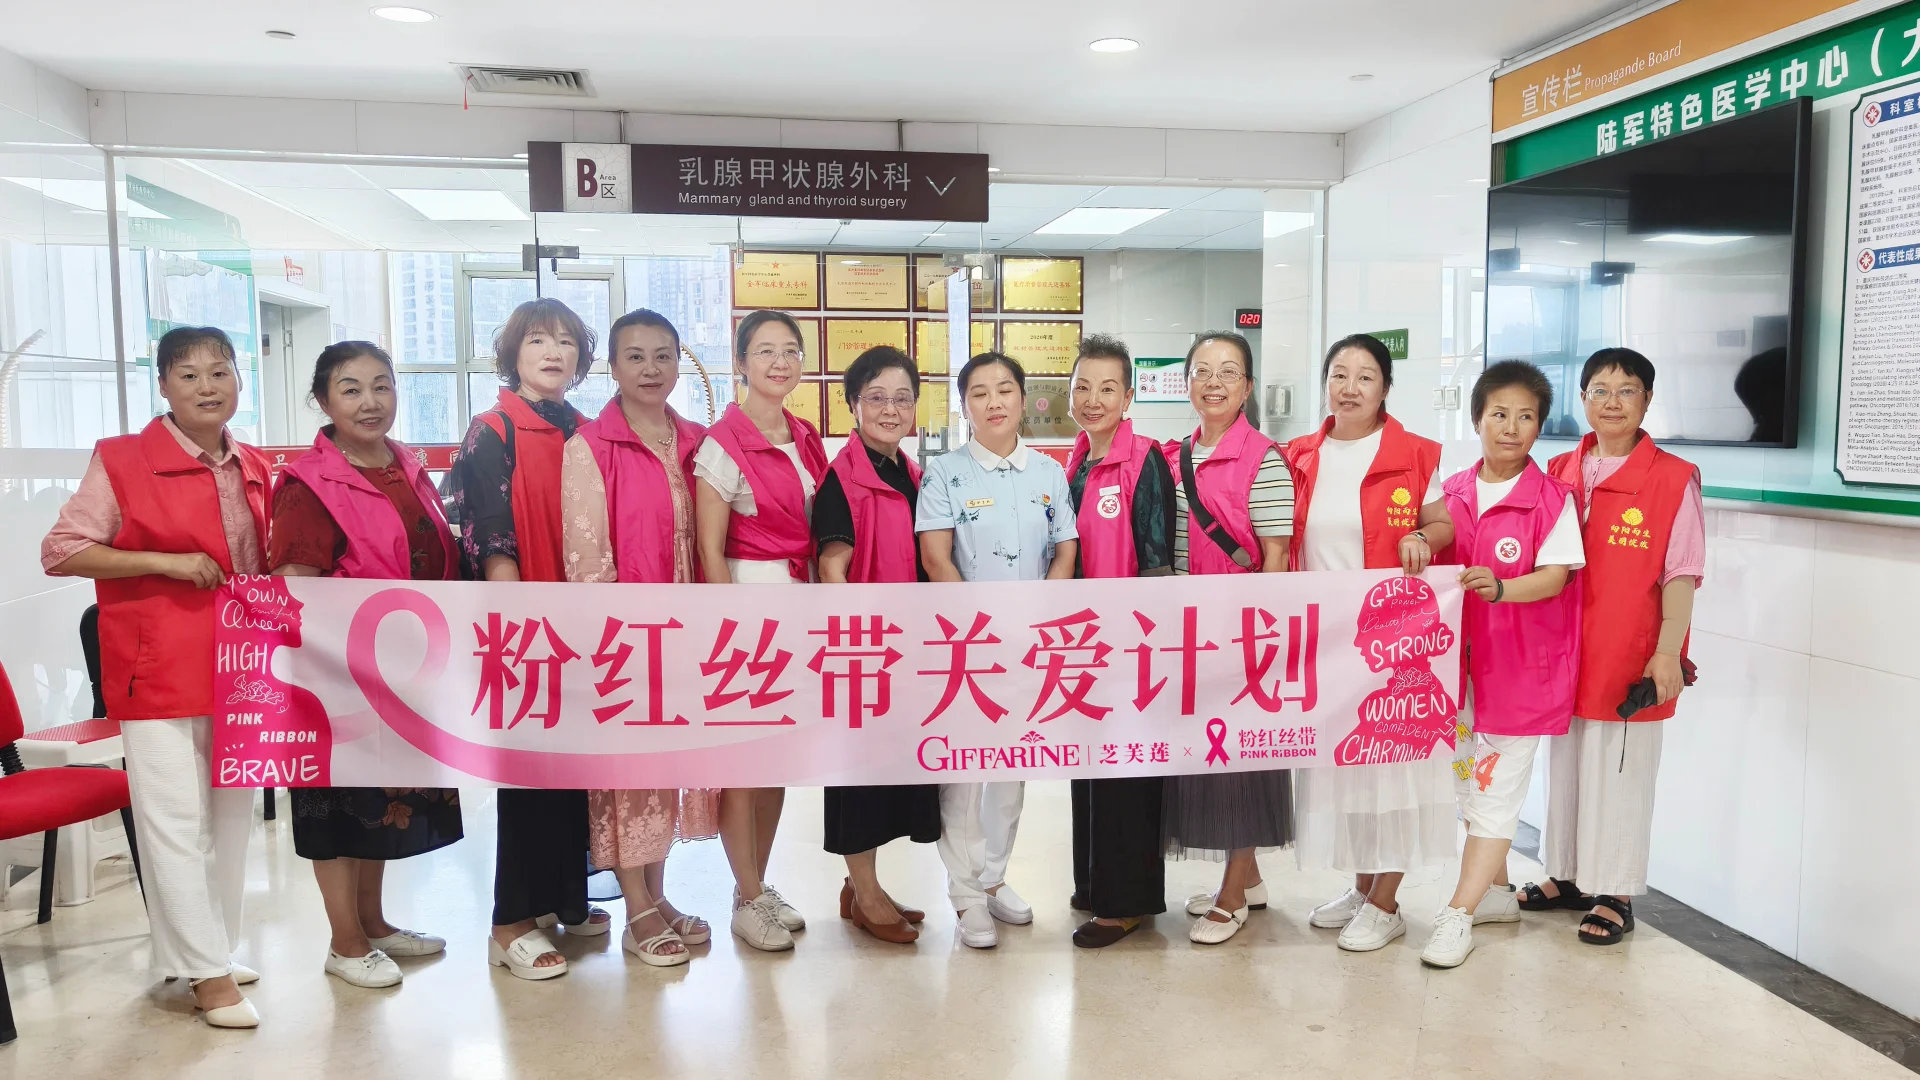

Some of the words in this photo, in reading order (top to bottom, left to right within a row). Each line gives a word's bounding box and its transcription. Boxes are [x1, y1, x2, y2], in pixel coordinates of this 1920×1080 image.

[1584, 56, 1645, 92] Propagande
[1648, 40, 1682, 68] Board
[1521, 64, 1583, 118] 宣传栏
[1889, 96, 1920, 116] 科室
[577, 158, 598, 198] B
[678, 156, 912, 192] 乳腺甲状腺外科
[601, 183, 616, 199] 区
[678, 192, 742, 206] Mammary
[749, 194, 783, 206] gland
[787, 194, 811, 206] and
[814, 194, 857, 208] thyroid
[860, 198, 907, 209] surgery
[1239, 313, 1260, 324] 020
[272, 453, 289, 468] 卫
[1370, 577, 1429, 608] GIRL'S
[221, 599, 289, 633] Queen
[217, 641, 268, 675] HIGH
[1369, 627, 1451, 669] STRONG
[471, 603, 1320, 731] 粉红丝带关爱计划
[226, 712, 264, 726] PINK
[259, 730, 318, 744] RIBBON
[1238, 726, 1317, 749] 粉红丝带
[917, 735, 1081, 772] GIFFARINE
[1099, 742, 1171, 765] 芝芙莲
[219, 754, 321, 785] BRAVE
